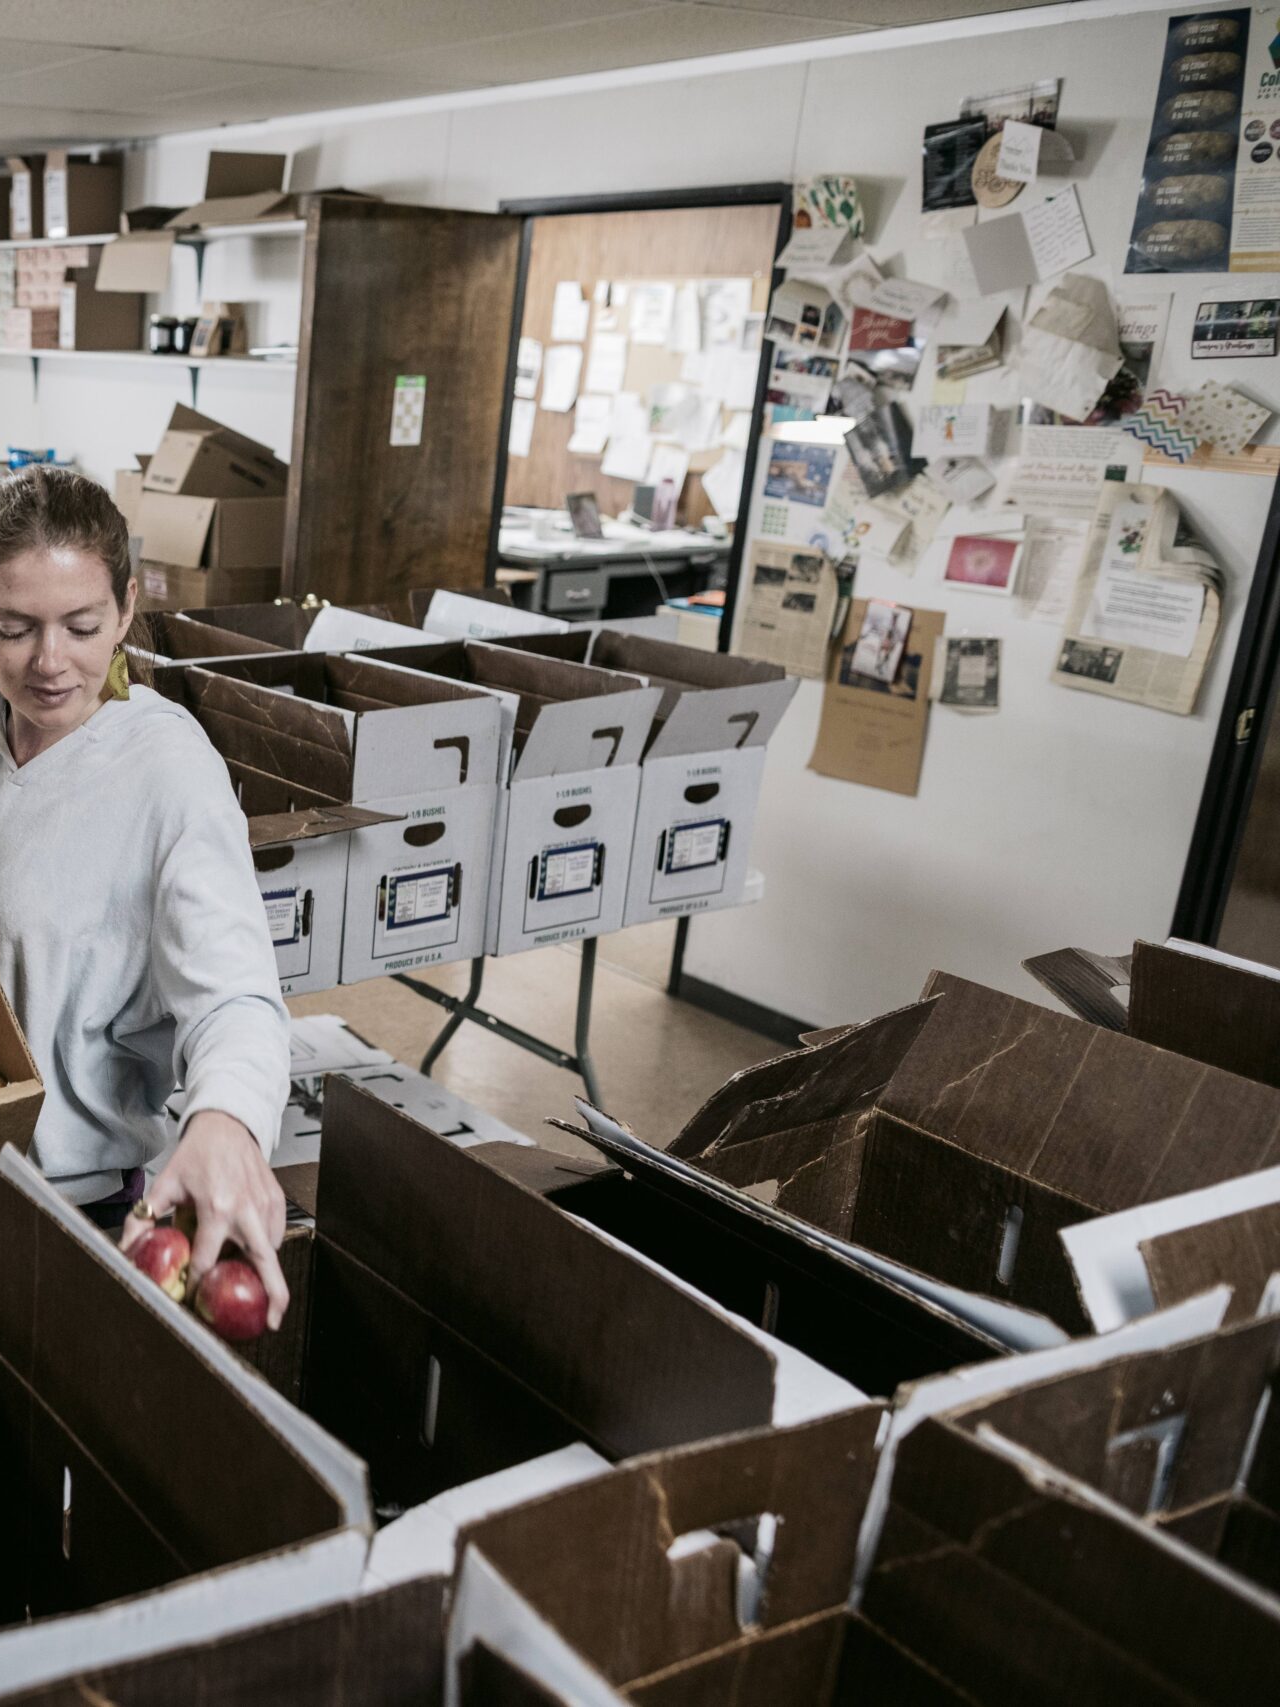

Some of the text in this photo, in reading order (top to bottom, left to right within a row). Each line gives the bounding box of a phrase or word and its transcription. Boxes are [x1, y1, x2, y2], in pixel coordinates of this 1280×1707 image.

[422, 806, 446, 818] BUSHEL
[534, 933, 562, 944] PRODUCE
[562, 931, 570, 940] OF
[384, 959, 414, 971] PRODUCE
[415, 957, 424, 966] OF
